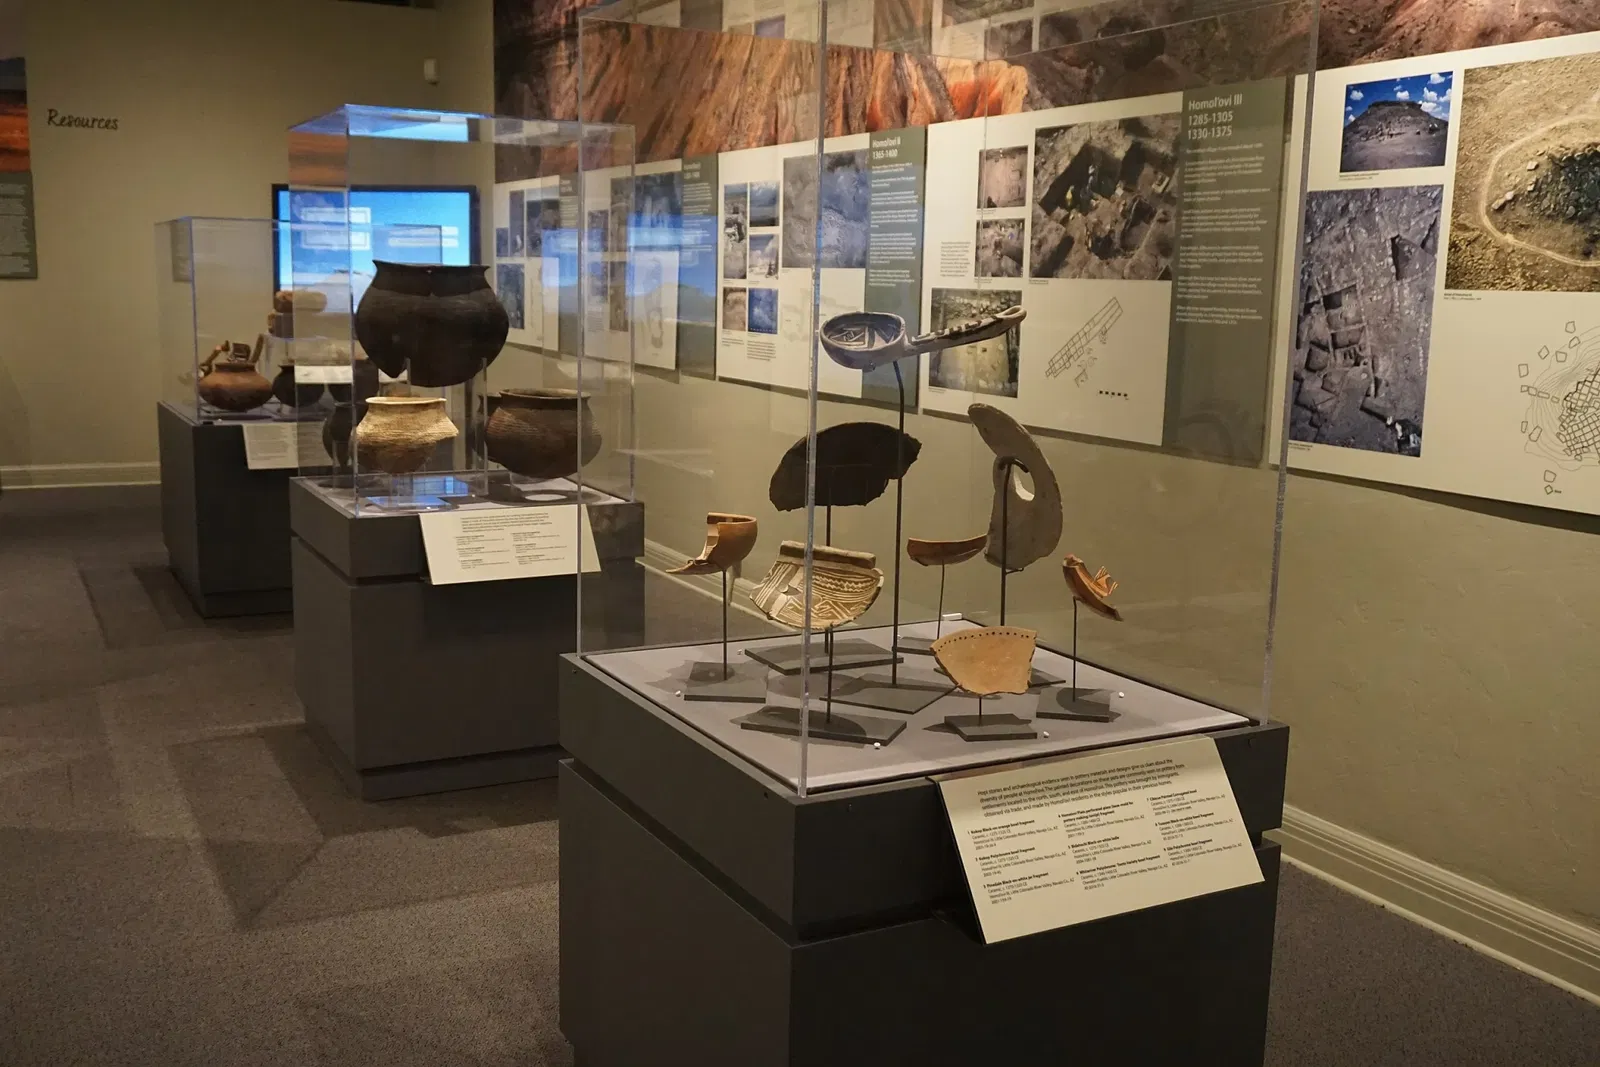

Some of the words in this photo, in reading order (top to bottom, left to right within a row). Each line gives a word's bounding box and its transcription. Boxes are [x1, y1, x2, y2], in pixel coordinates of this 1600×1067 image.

[1233, 93, 1243, 106] III
[47, 108, 119, 130] Resources
[1188, 111, 1233, 126] 1285-1305
[1187, 126, 1232, 140] 1330-1375
